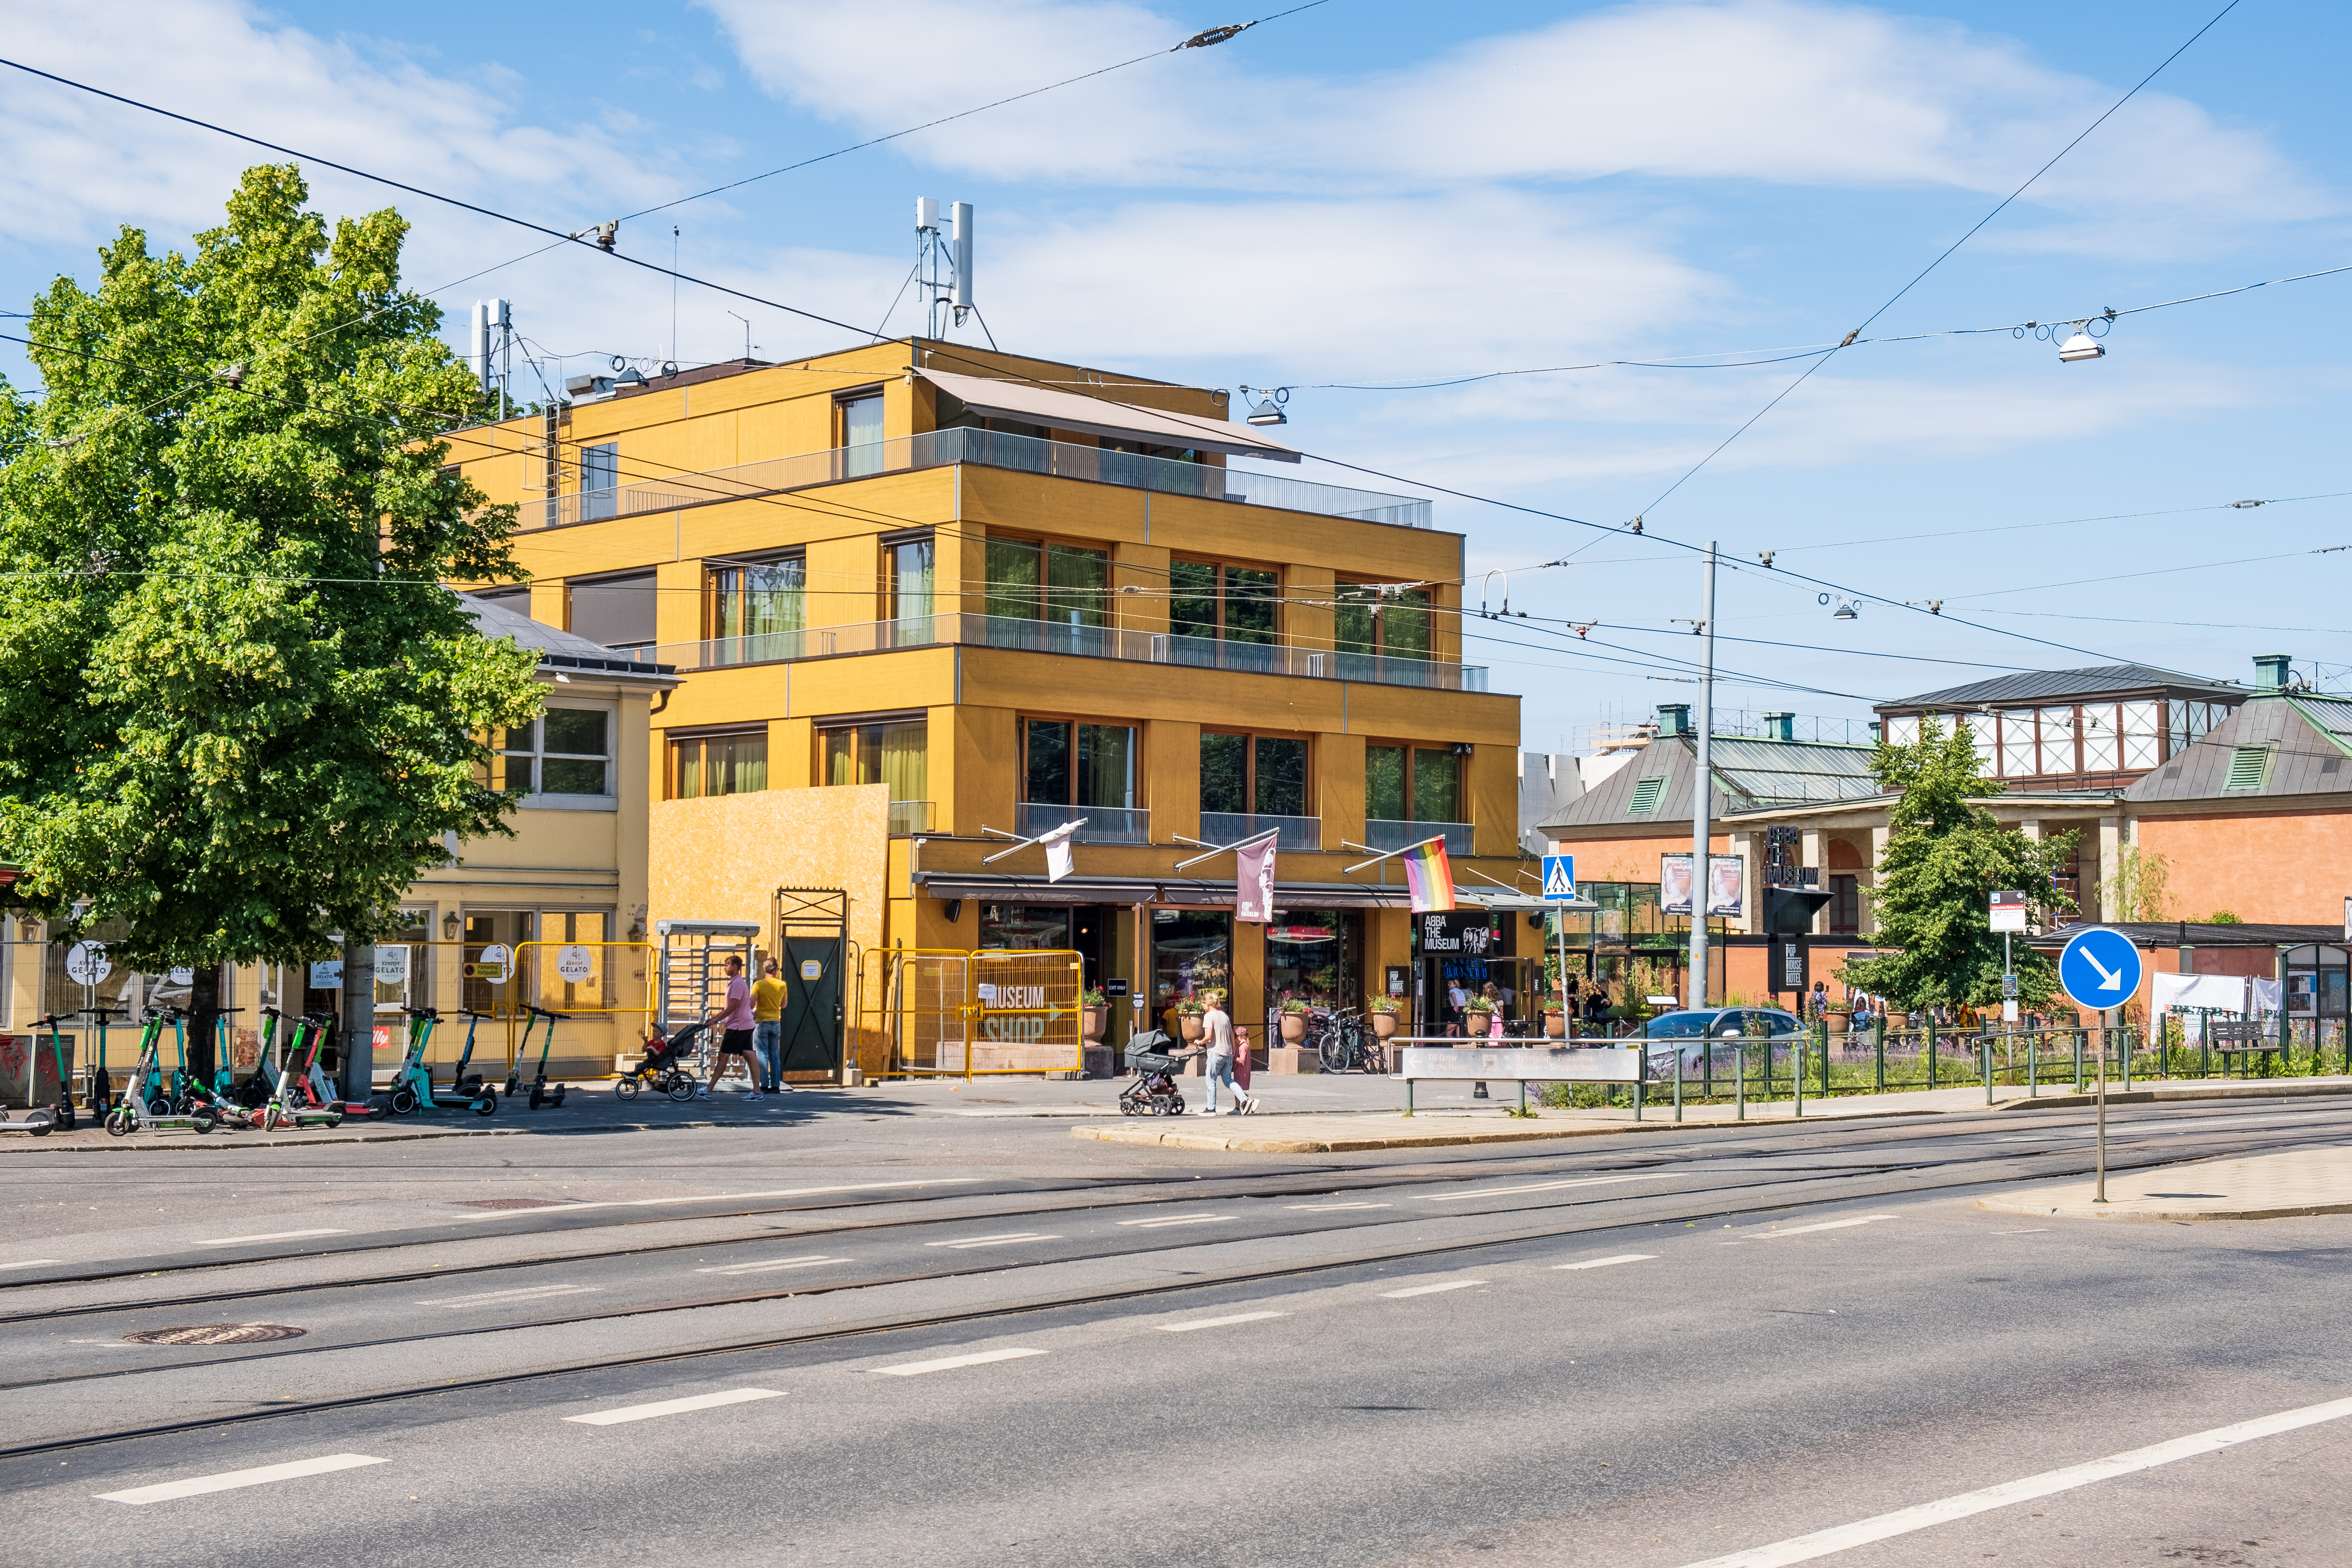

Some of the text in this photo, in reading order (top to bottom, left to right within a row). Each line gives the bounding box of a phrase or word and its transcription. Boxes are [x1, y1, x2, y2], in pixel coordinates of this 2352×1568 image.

[1766, 825, 1799, 845] ABBA
[1767, 845, 1791, 864] THE
[1766, 866, 1818, 885] MUSEUM
[1425, 916, 1446, 927] ABBA
[1425, 927, 1441, 938] THE
[1425, 938, 1459, 949] MUSEUM
[1786, 946, 1796, 957] POP
[1786, 959, 1802, 970] HOUSE
[1786, 972, 1802, 983] HOTEL
[1439, 1054, 1458, 1062] färjor
[1549, 1063, 1599, 1072] Skeppsholmen
